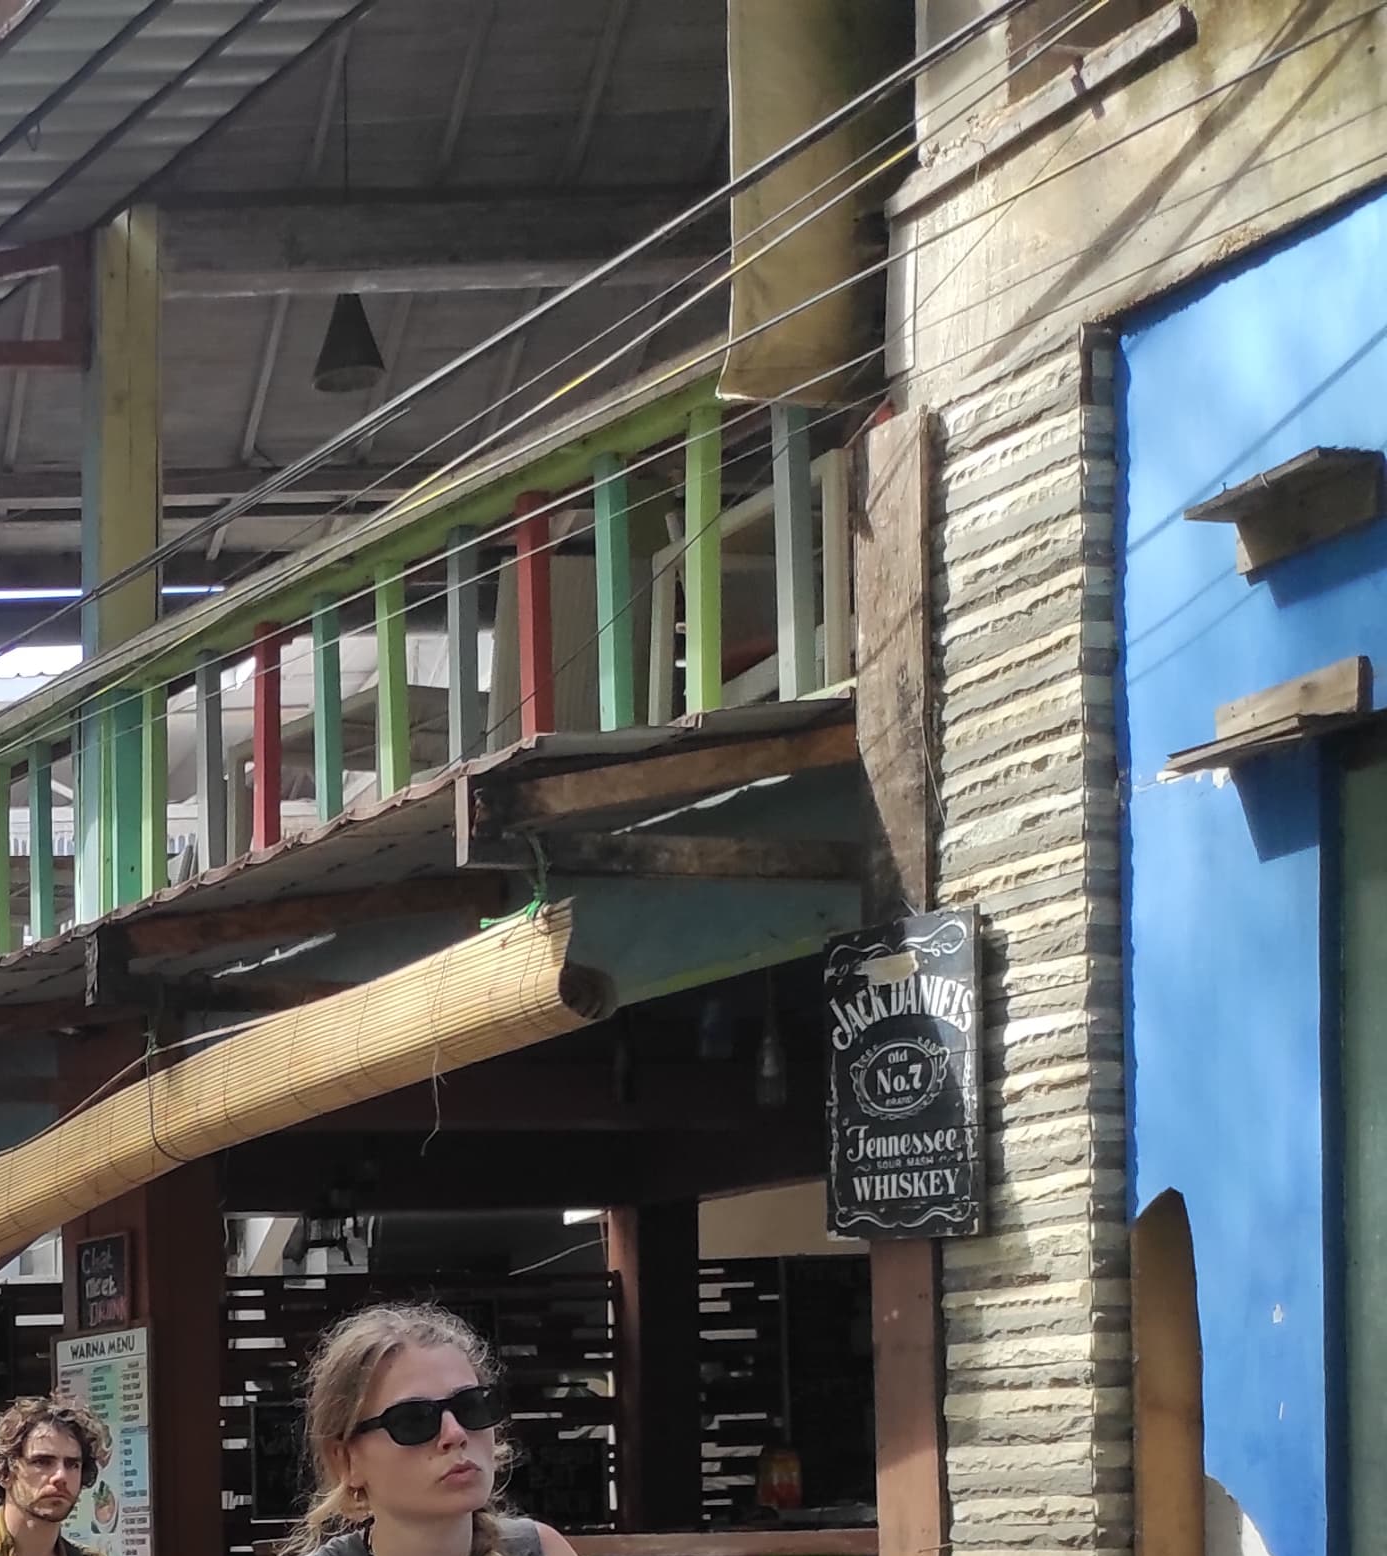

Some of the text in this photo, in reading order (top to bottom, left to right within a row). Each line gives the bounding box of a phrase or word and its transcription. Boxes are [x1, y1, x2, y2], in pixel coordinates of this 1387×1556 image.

[828, 984, 889, 1051] JACK
[887, 1050, 908, 1064] Old
[846, 1124, 958, 1162] Tennessee
[877, 1156, 935, 1170] SOUR MASH
[852, 1168, 960, 1201] WHISKEY
[70, 1334, 136, 1361] WARNA MENU
